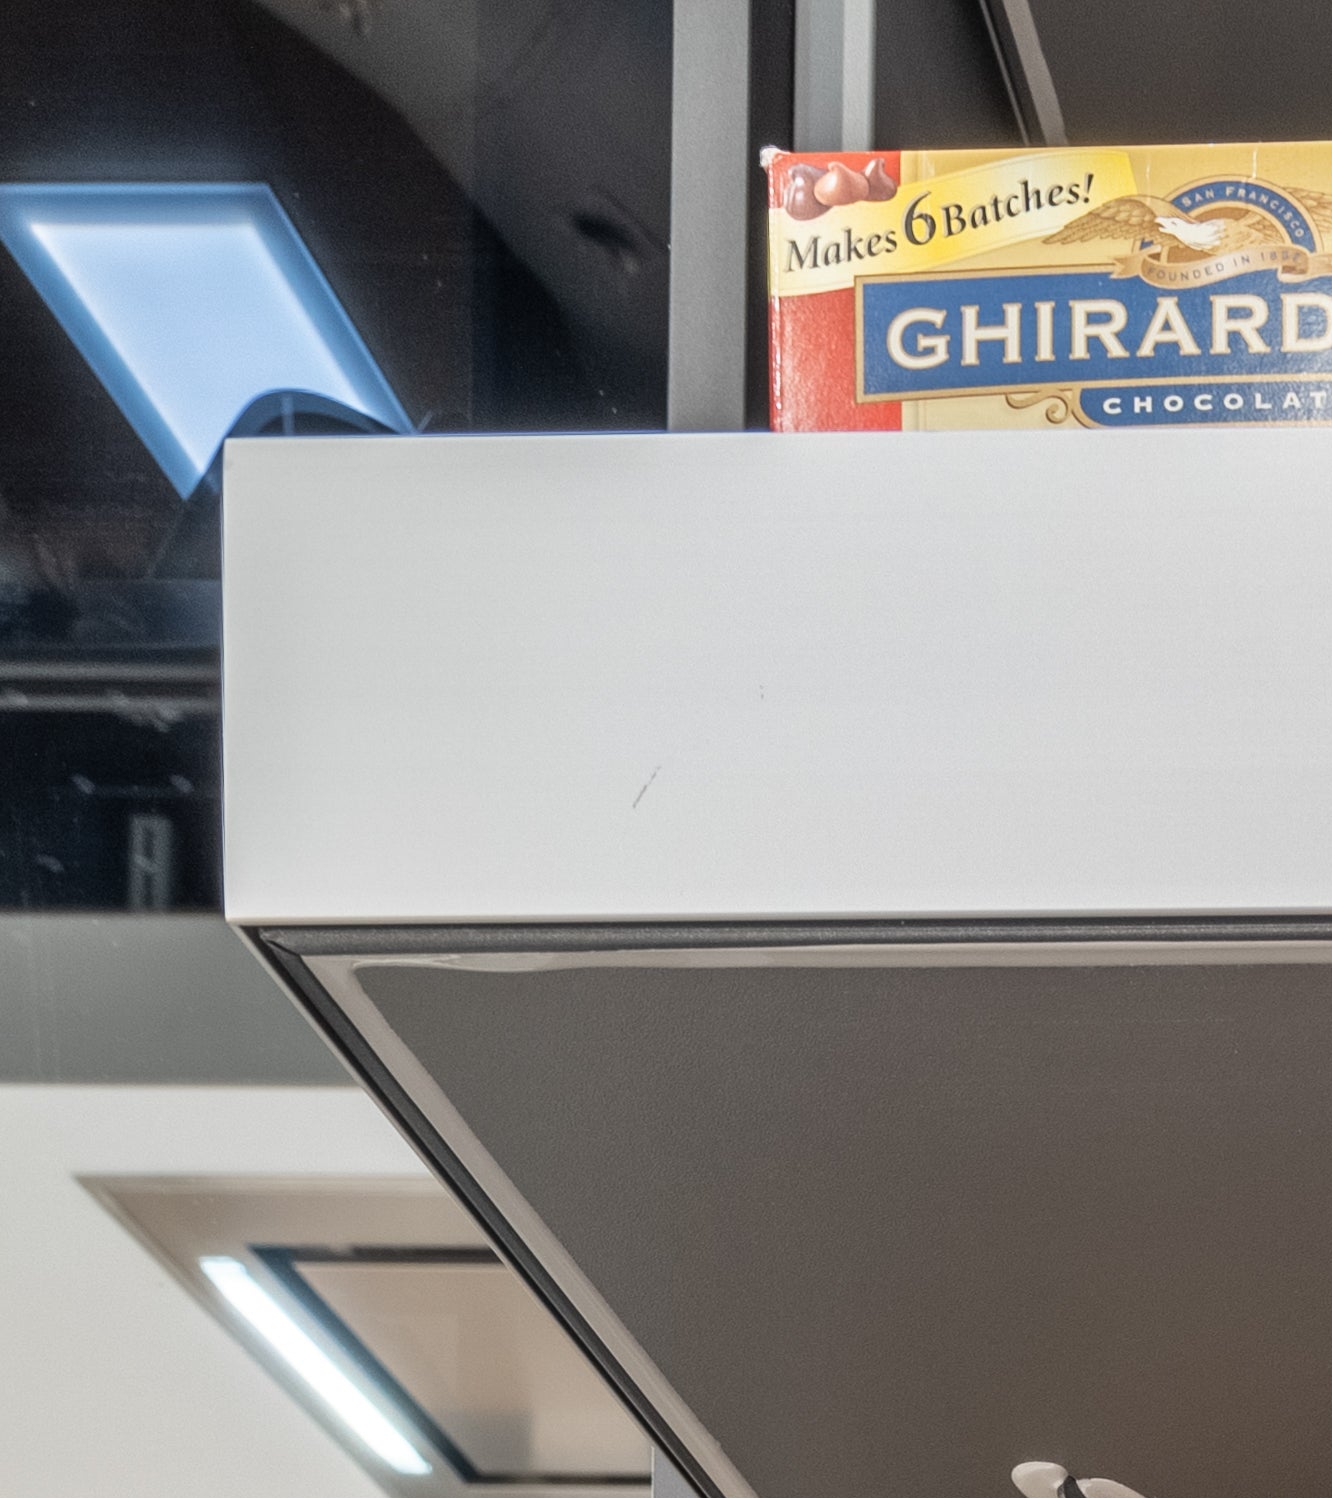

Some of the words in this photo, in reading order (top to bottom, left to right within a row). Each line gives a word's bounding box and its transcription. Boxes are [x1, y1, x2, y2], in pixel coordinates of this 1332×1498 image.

[784, 228, 898, 273] Makes
[904, 191, 937, 246] 6
[942, 173, 1094, 239] Batches!
[1181, 189, 1215, 208] SAN
[1225, 186, 1304, 238] FRANCISCO
